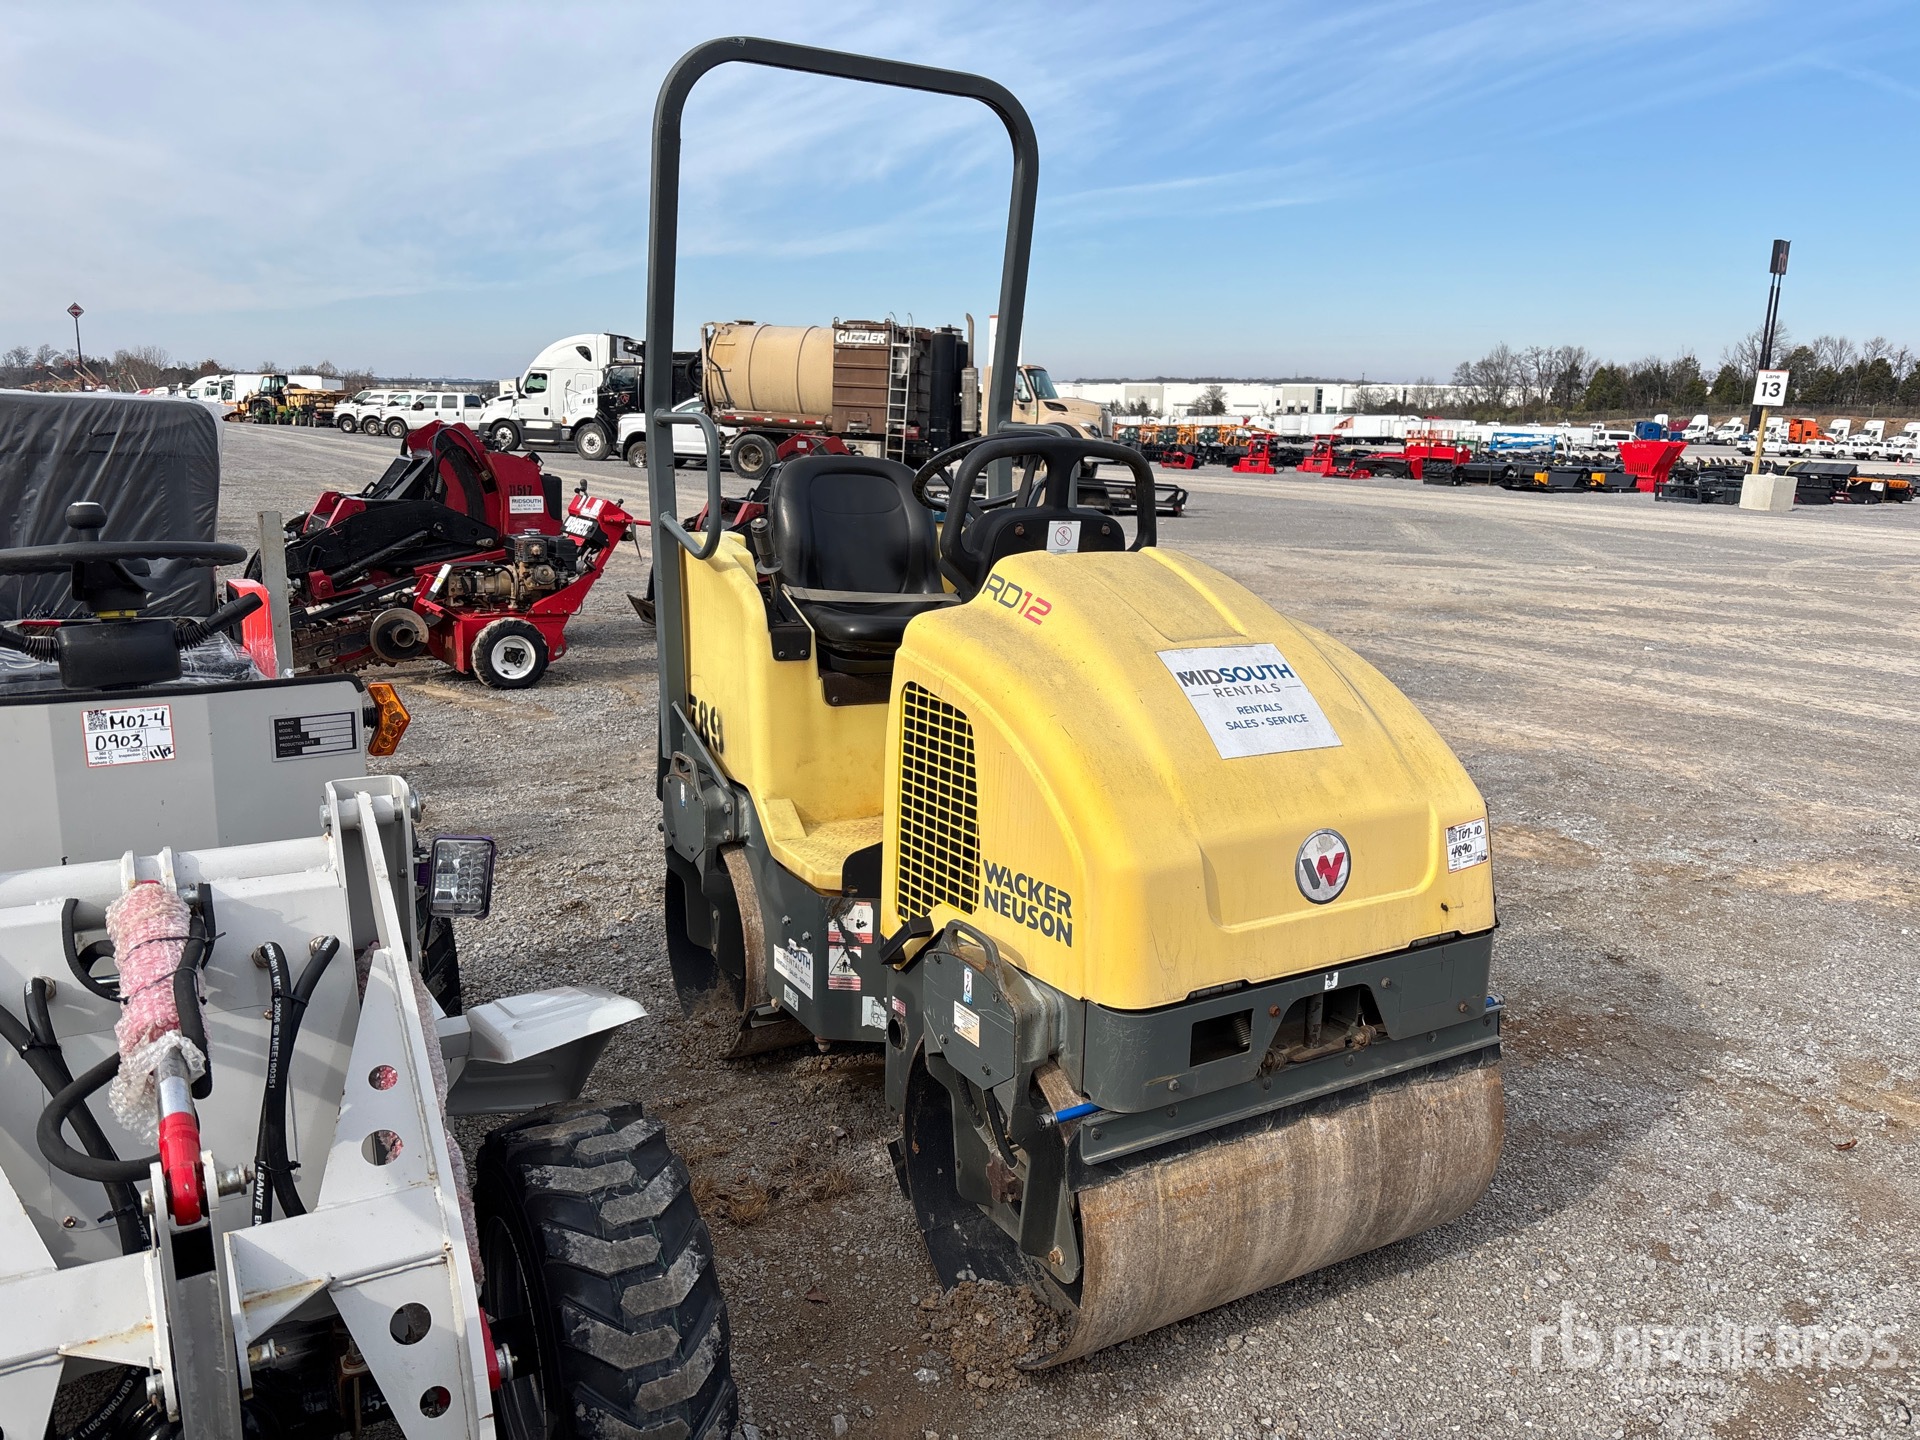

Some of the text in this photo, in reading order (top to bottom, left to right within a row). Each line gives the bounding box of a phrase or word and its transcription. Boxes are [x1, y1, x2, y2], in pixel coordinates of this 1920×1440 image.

[836, 330, 886, 344] GUZZLER
[1761, 382, 1781, 397] 13
[981, 573, 1052, 626] RD12
[1176, 663, 1295, 687] MIDSOUTH
[1212, 683, 1281, 698] RENTALS
[1236, 703, 1283, 715] RENTALS
[109, 710, 165, 730] M02-4
[1225, 714, 1309, 731] SALES SERVICE
[95, 733, 143, 751] 0903
[983, 859, 1073, 919] WACKER
[984, 884, 1073, 948] NEUSON
